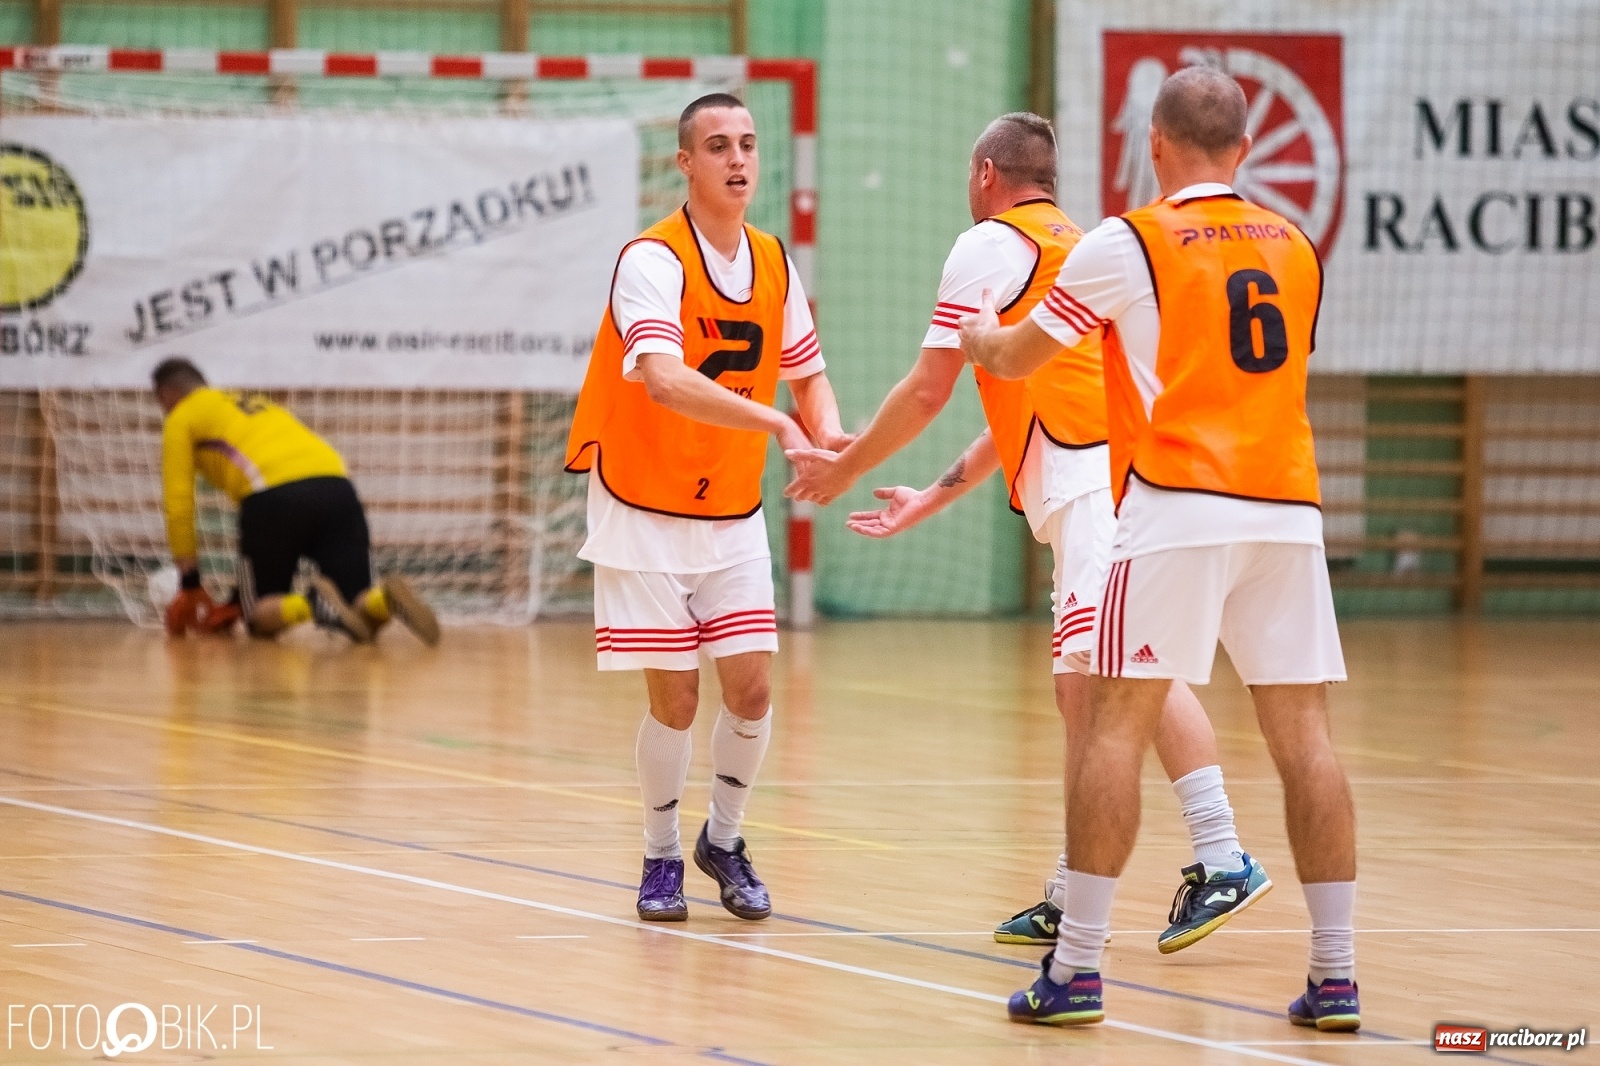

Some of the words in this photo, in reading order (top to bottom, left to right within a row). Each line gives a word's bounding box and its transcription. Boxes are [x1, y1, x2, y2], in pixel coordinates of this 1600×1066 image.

[1203, 224, 1292, 243] PATRICK
[1364, 190, 1597, 253] RACIB
[125, 269, 234, 343] JEST
[252, 250, 297, 299] W
[1226, 268, 1288, 373] 6
[694, 478, 710, 500] 2
